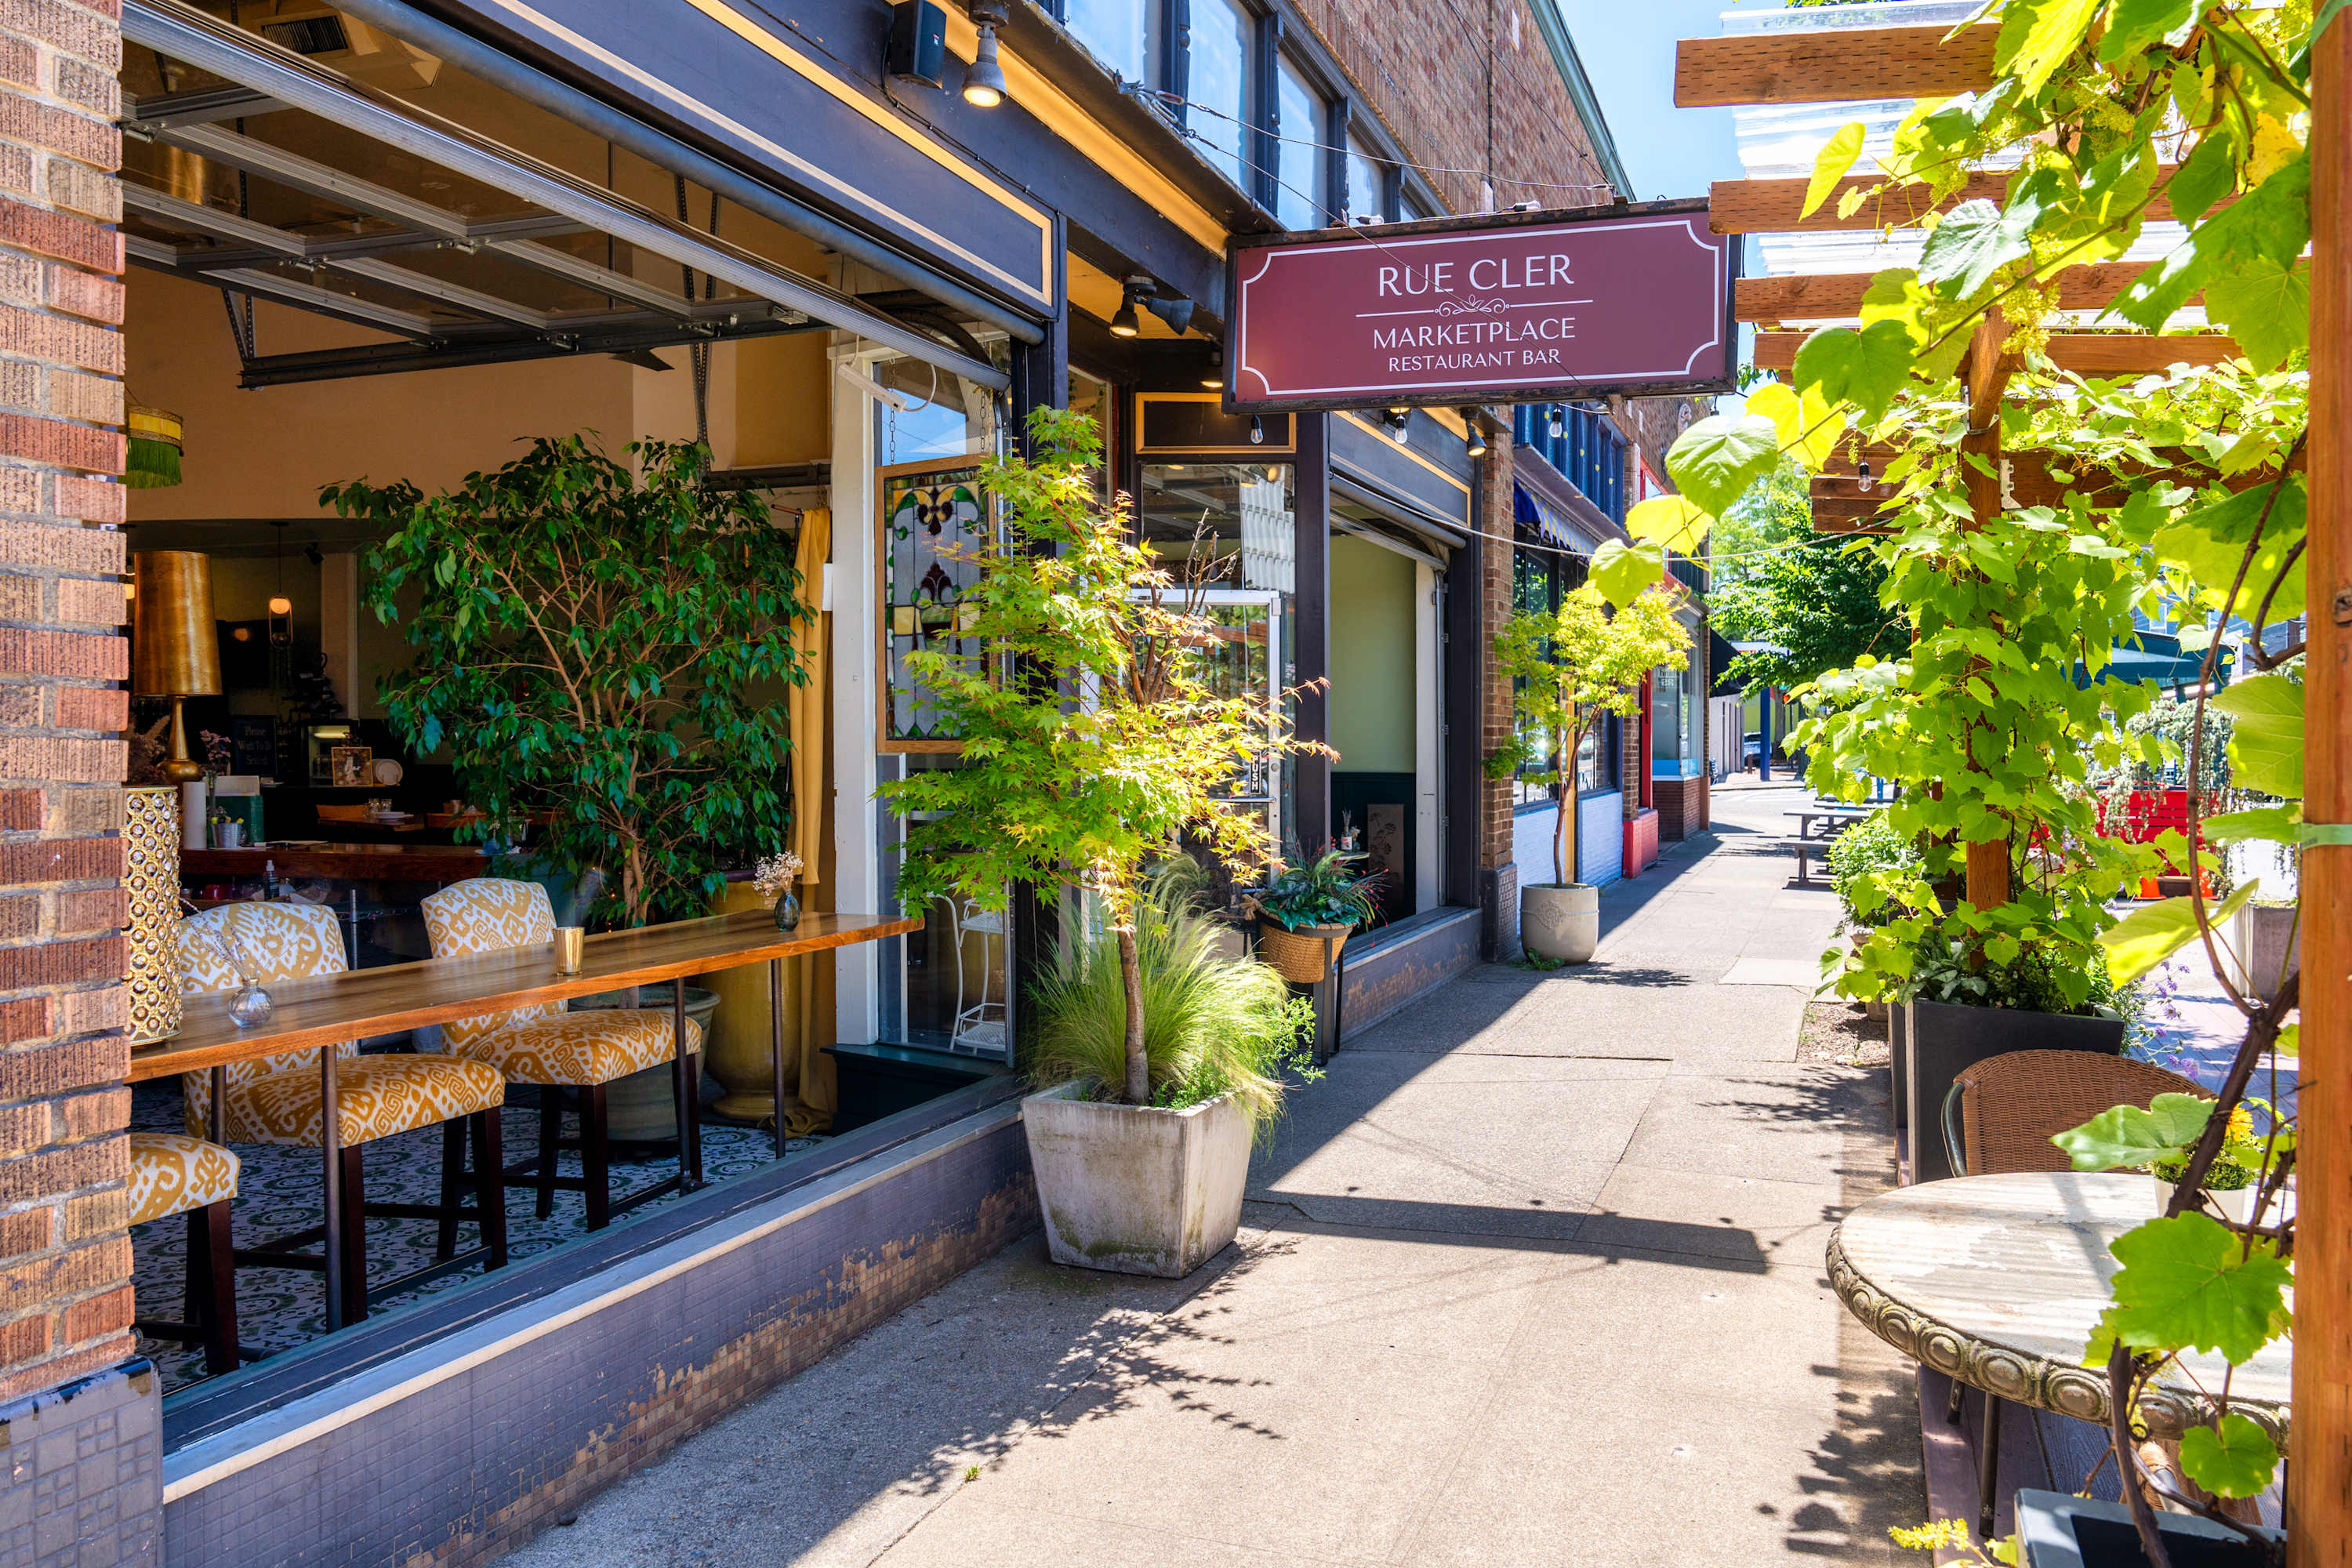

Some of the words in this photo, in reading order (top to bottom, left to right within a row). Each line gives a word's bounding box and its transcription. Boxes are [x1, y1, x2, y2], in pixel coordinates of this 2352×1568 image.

[1379, 263, 1455, 296] RUE
[1469, 254, 1574, 290] CLER
[1374, 318, 1576, 349] MARKETPLACE
[1388, 351, 1515, 372] RESTAURANT
[1523, 349, 1561, 365] BAR
